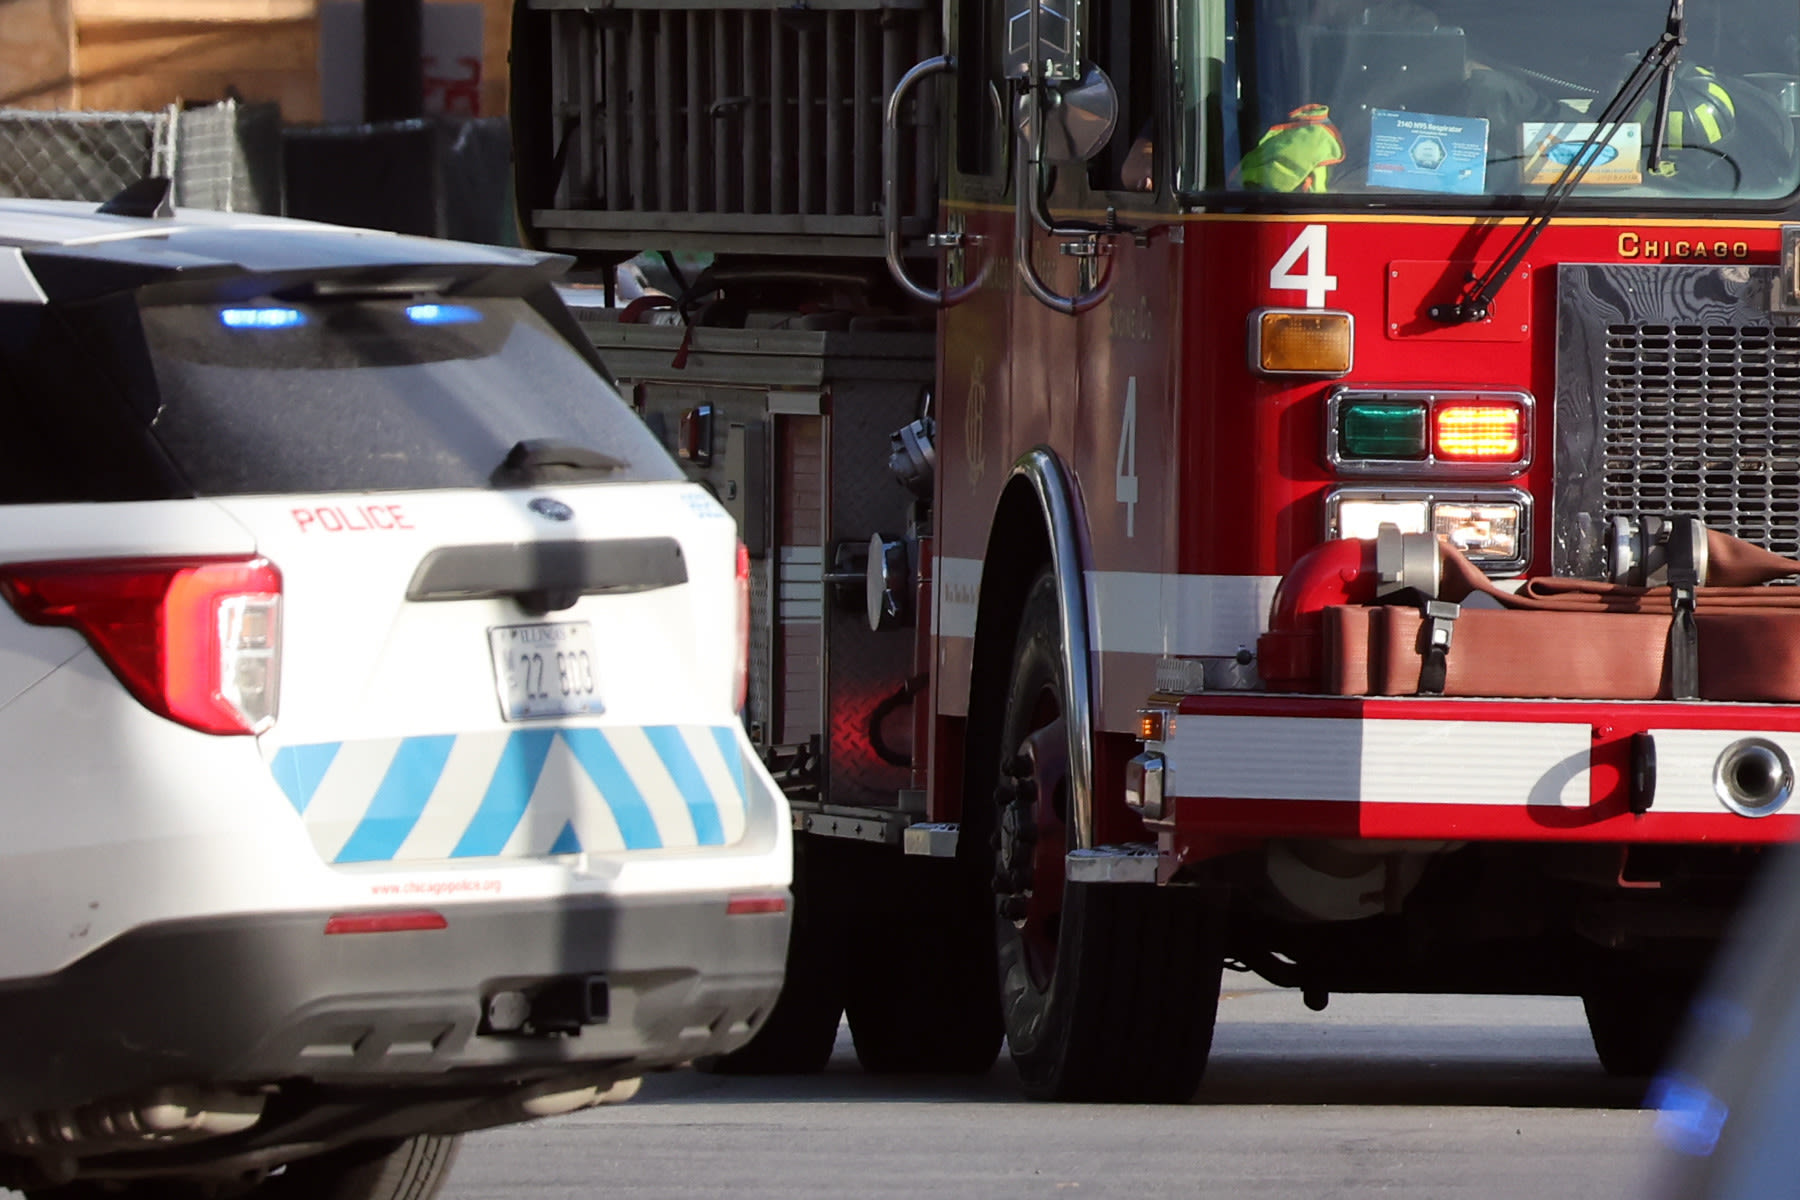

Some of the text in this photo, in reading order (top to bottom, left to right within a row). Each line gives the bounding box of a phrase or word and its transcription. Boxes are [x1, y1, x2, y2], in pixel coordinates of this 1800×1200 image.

[1269, 224, 1337, 308] 4
[1618, 232, 1749, 258] CHICAGO
[1116, 376, 1138, 538] 4
[290, 504, 416, 533] POLICE
